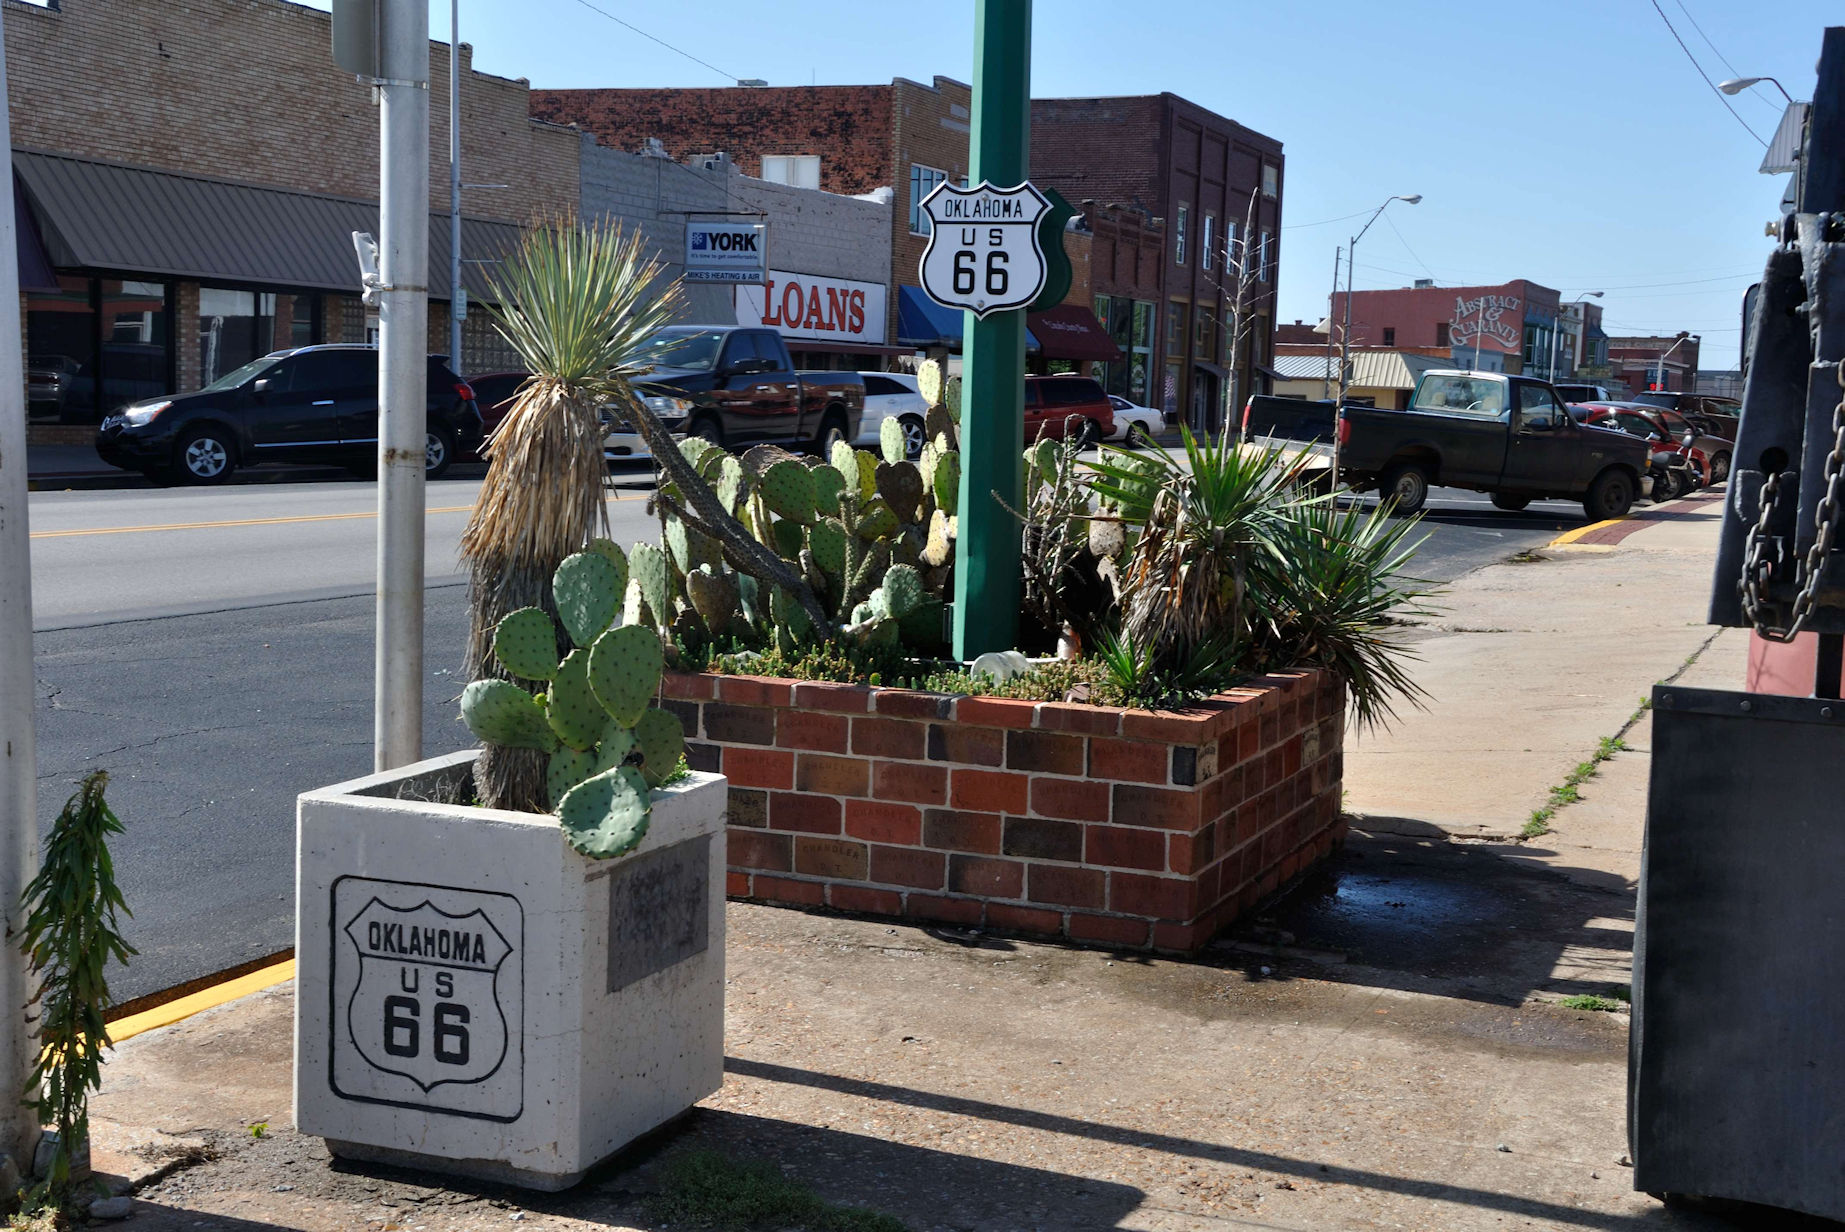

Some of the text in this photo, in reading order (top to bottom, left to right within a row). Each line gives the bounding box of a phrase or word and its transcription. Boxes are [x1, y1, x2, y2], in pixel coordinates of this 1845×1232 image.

[945, 199, 1023, 218] OKLAHOMA
[708, 232, 758, 252] YORK
[687, 271, 710, 279] MIKE'S
[711, 272, 740, 280] HEATING
[747, 273, 760, 281] AIR
[953, 250, 1009, 295] 66
[762, 280, 865, 333] LOANS
[1449, 295, 1521, 325] ABSTRACT
[1485, 307, 1504, 321] &
[802, 843, 860, 861] CHANDLER
[368, 921, 487, 965] OKLAHOMA
[383, 995, 470, 1066] 66
